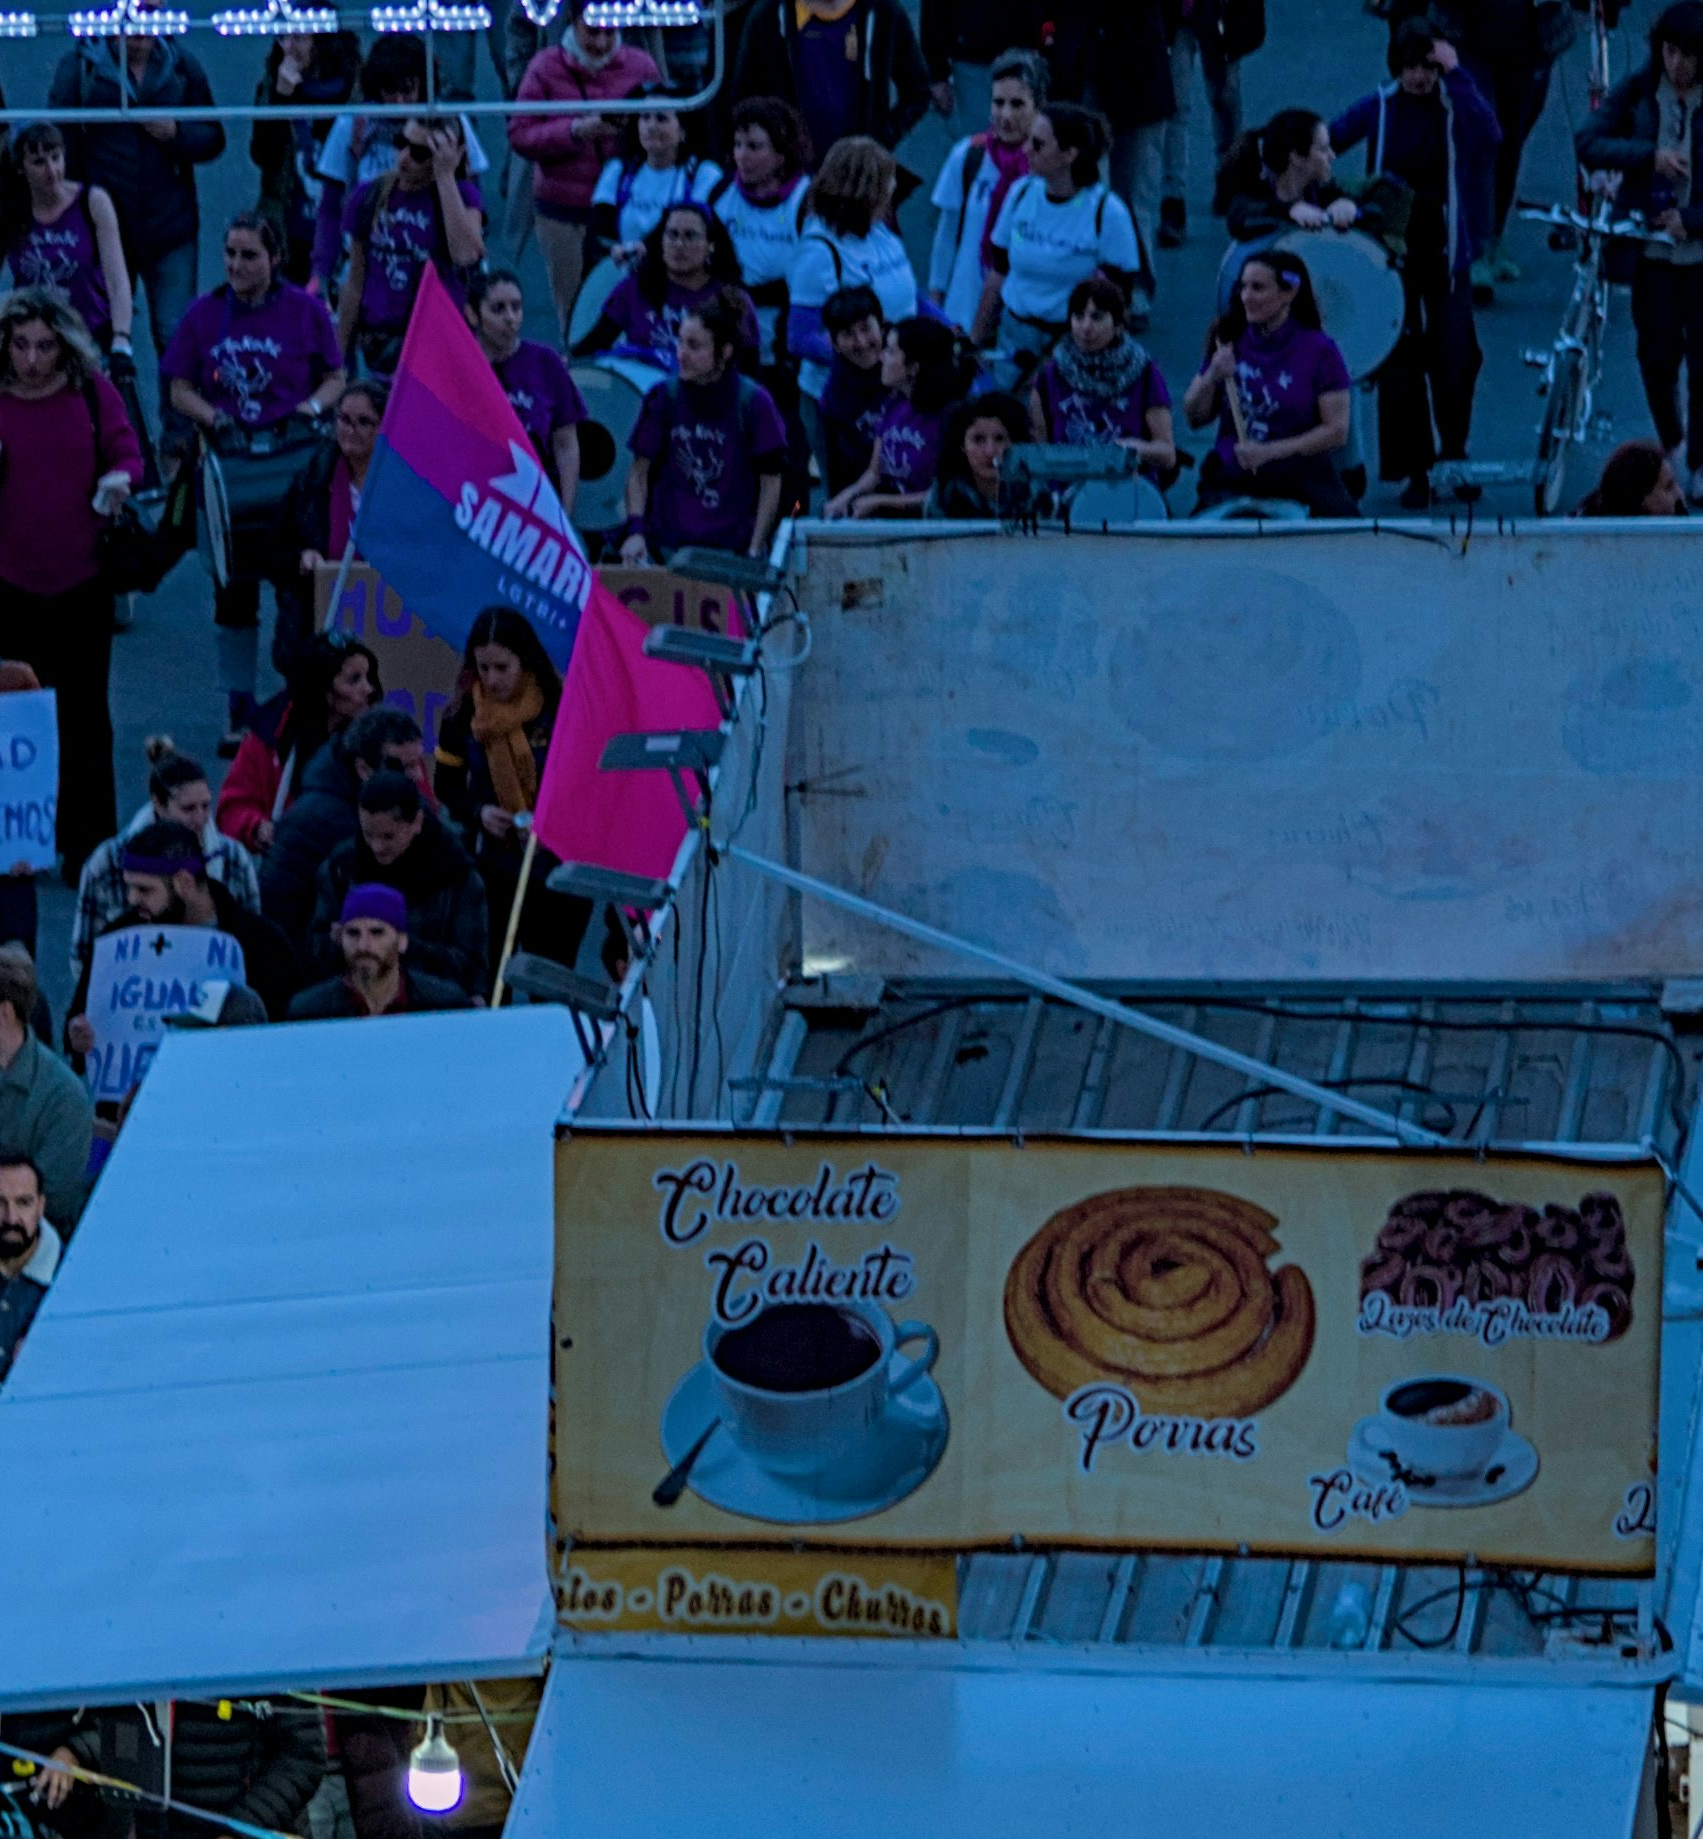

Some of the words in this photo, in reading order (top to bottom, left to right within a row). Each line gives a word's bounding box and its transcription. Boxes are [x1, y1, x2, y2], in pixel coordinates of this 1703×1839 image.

[657, 1161, 896, 1242] Chocolate
[709, 1241, 911, 1321] Caliente
[1476, 1302, 1606, 1344] Chocolate
[1069, 1388, 1255, 1471] Porras
